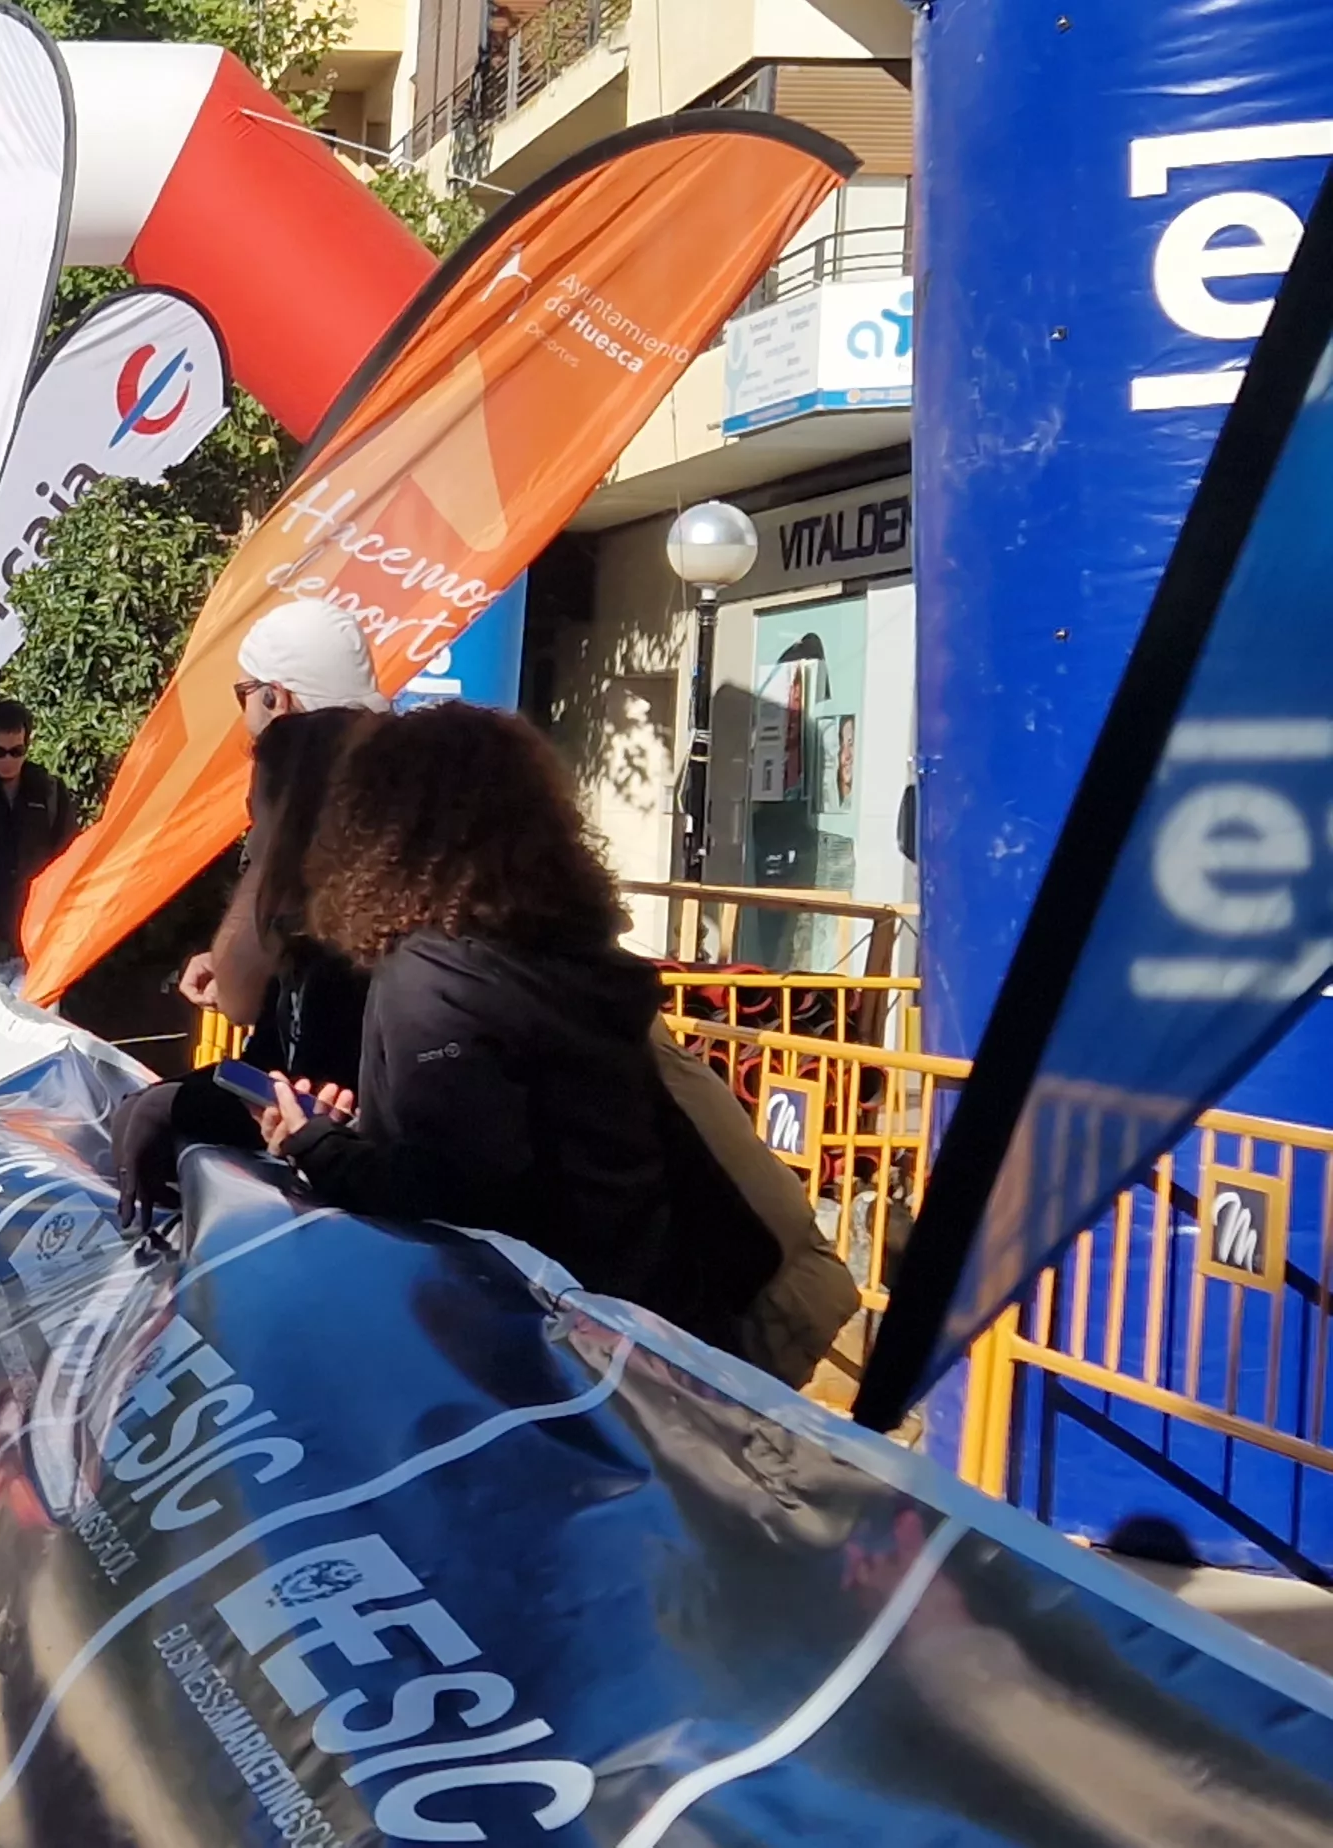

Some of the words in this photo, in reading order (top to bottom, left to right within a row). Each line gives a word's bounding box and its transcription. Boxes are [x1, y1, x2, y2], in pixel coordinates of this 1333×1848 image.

[544, 294, 570, 319] de
[568, 308, 645, 373] Huesca
[557, 273, 691, 364] Ayuntamiento
[103, 1335, 304, 1531] ESIC
[258, 1599, 596, 1842] ESIC
